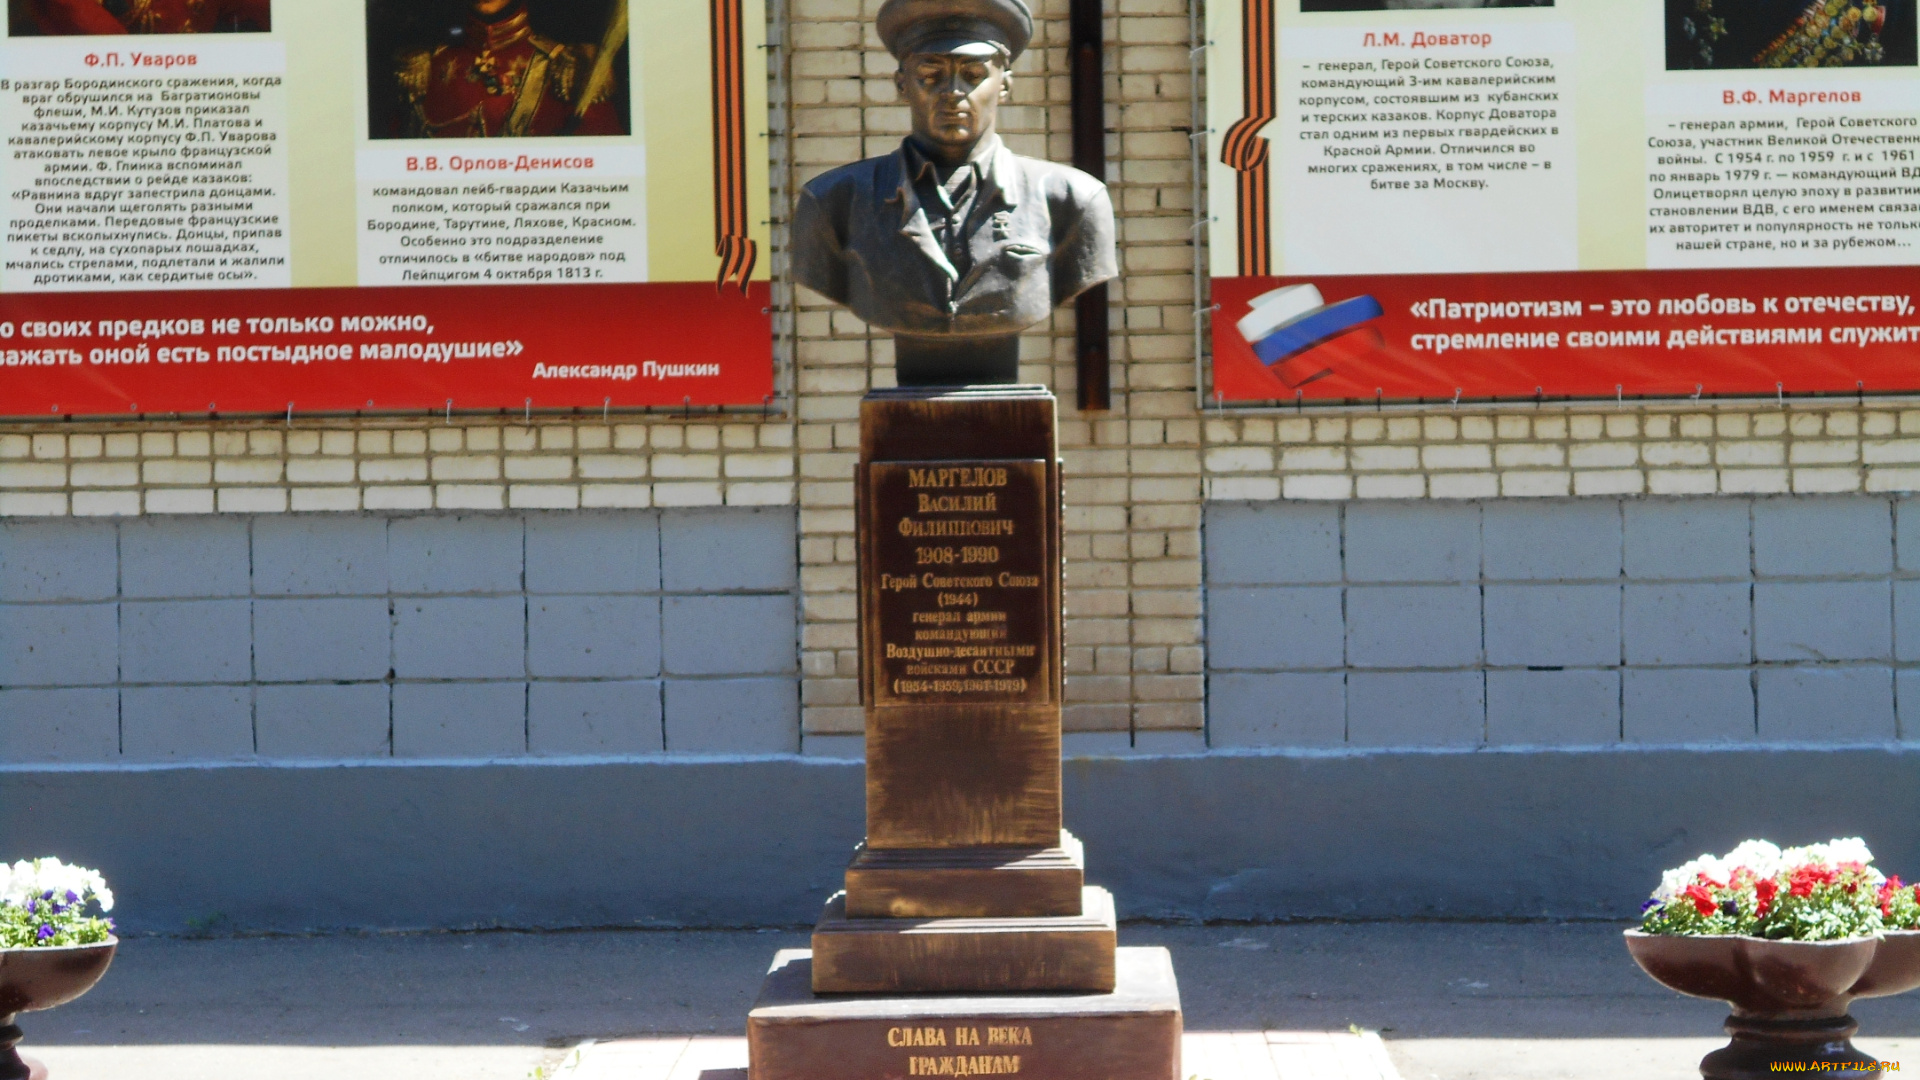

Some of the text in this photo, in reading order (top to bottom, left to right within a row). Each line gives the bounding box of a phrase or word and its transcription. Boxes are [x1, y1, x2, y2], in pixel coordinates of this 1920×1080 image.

[1362, 31, 1492, 48] Л.М. Доватор
[83, 52, 198, 68] Ф.П. Уваров
[1317, 55, 1554, 72] генерал, Герой Советского Союза,
[13, 80, 60, 92] разгар
[63, 77, 163, 90] Бородинского
[166, 77, 239, 89] сражения,
[242, 76, 282, 87] когда
[1301, 74, 1556, 89] командующий 3-им кавалерийским
[22, 94, 53, 106] враг
[56, 91, 133, 105] обрушился
[160, 90, 260, 102] Багратионовы
[1298, 90, 1559, 107] корпусом, состоявшим из кубанских
[1722, 89, 1862, 106] В.Ф. Маргелов
[33, 104, 250, 119] флеши, М.И. Кутузов приказал
[1312, 107, 1557, 124] терских казаков. Корпус Доватора
[20, 116, 251, 132] казачьему корпусу М.И. Платова
[1679, 115, 1918, 132] генерал армии, Герой Советского
[7, 130, 277, 146] кавалерийскому корпусу Ф.П. Уварова
[1299, 125, 1547, 140] стал одним из первых гвардейских
[1647, 136, 1696, 148] Союза,
[1699, 137, 1763, 149] участник
[1766, 134, 1828, 146] Великой
[1323, 142, 1536, 158] Красной Армии. Отличился во
[1657, 148, 1915, 165] войны. 1954 по 1959 1961
[406, 155, 594, 172] В.В. Орлов-Денисов
[1307, 160, 1528, 175] многих сражениях, том числе
[1648, 172, 1666, 182] по
[1669, 172, 1720, 183] январь
[1724, 168, 1760, 180] 1979
[1791, 167, 1897, 180] командующий
[372, 182, 629, 197] командовал лейб-гвардии Казачьим
[1369, 177, 1489, 190] битве за Москву.
[1652, 187, 1748, 200] Олицетворял
[1751, 187, 1798, 199] целую
[1801, 187, 1840, 198] эпоху
[391, 200, 611, 213] полком, который сражался при
[366, 216, 636, 232] Бородине, Тарутине, Ляхове, Красном.
[399, 234, 604, 247] Особенно это подразделение
[1675, 236, 1911, 251] нашей стране, но за рубежом…
[378, 250, 626, 264] отличилось «битве народов» под
[32, 270, 257, 285] дротиками, как сердитые осы».
[401, 266, 591, 281] Лейпцигом 4 октября 1813
[1409, 298, 1582, 321] «Патриотизм
[1610, 298, 1651, 316] это
[1657, 293, 1756, 315] любовь
[1762, 296, 1779, 313] к
[1783, 295, 1915, 315] отечеству,
[20, 320, 92, 337] своих
[98, 318, 205, 340] предков
[211, 317, 241, 334] не
[245, 316, 334, 333] только
[340, 314, 434, 334] можно,
[1410, 331, 1560, 353] стремление
[1565, 330, 1660, 347] своими
[1665, 325, 1823, 348] действиями
[88, 343, 150, 364] оной
[156, 346, 211, 363] есть
[216, 343, 354, 363] постыдное
[359, 340, 524, 362] малодушие»
[531, 360, 720, 380] Александр Пушкин
[908, 467, 1007, 487] МАРГЕЛОВ
[915, 545, 1000, 564] 1908-1990
[887, 1026, 1033, 1046] СЛАВА НА ВЕКА
[908, 1055, 1020, 1078] ГРАЖДАНАМ
